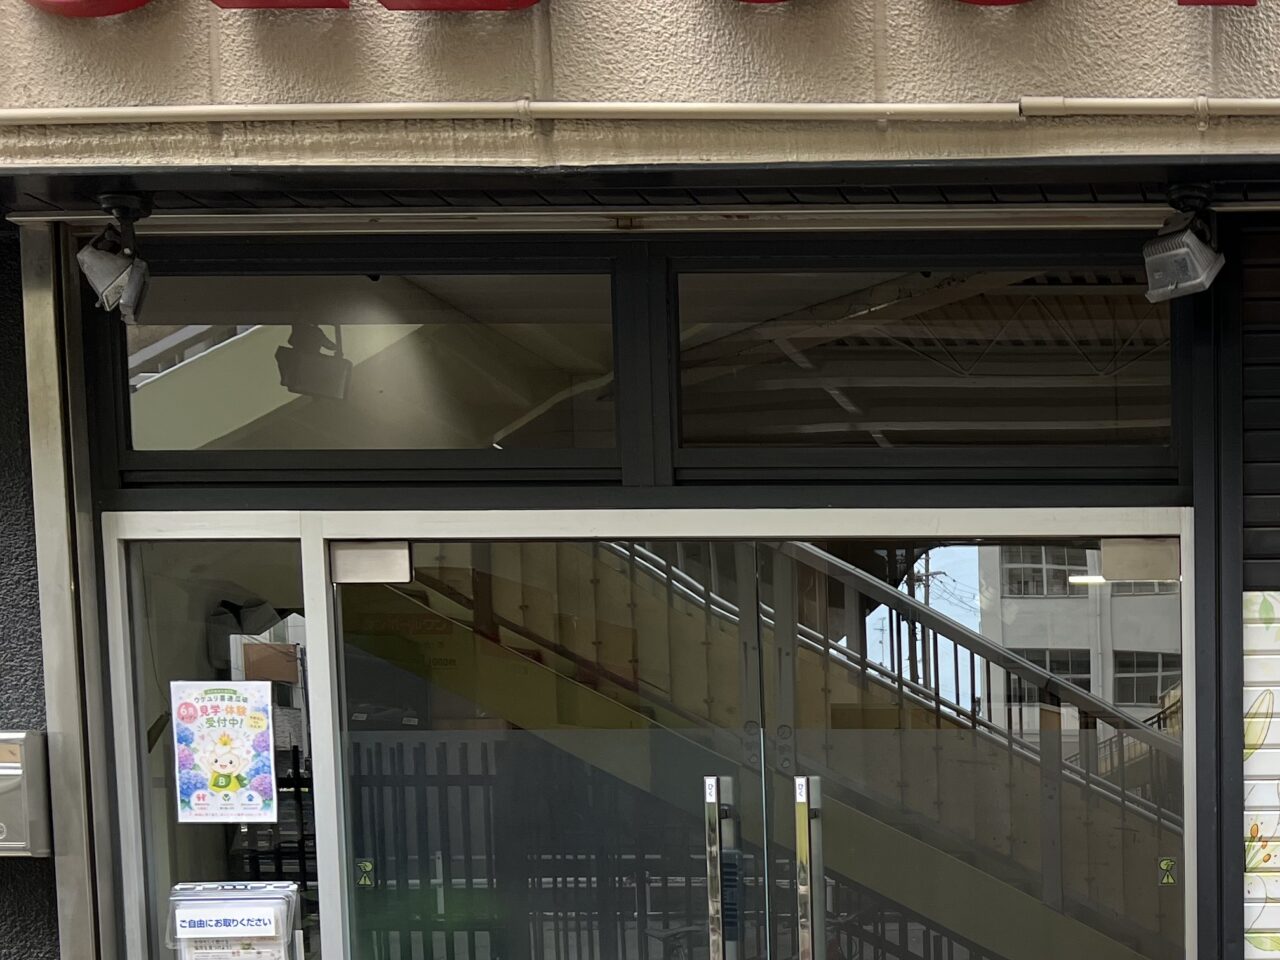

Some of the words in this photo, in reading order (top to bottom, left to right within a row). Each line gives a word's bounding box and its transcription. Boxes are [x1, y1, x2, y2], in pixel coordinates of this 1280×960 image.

[179, 918, 272, 928] ご自由にお取りください
